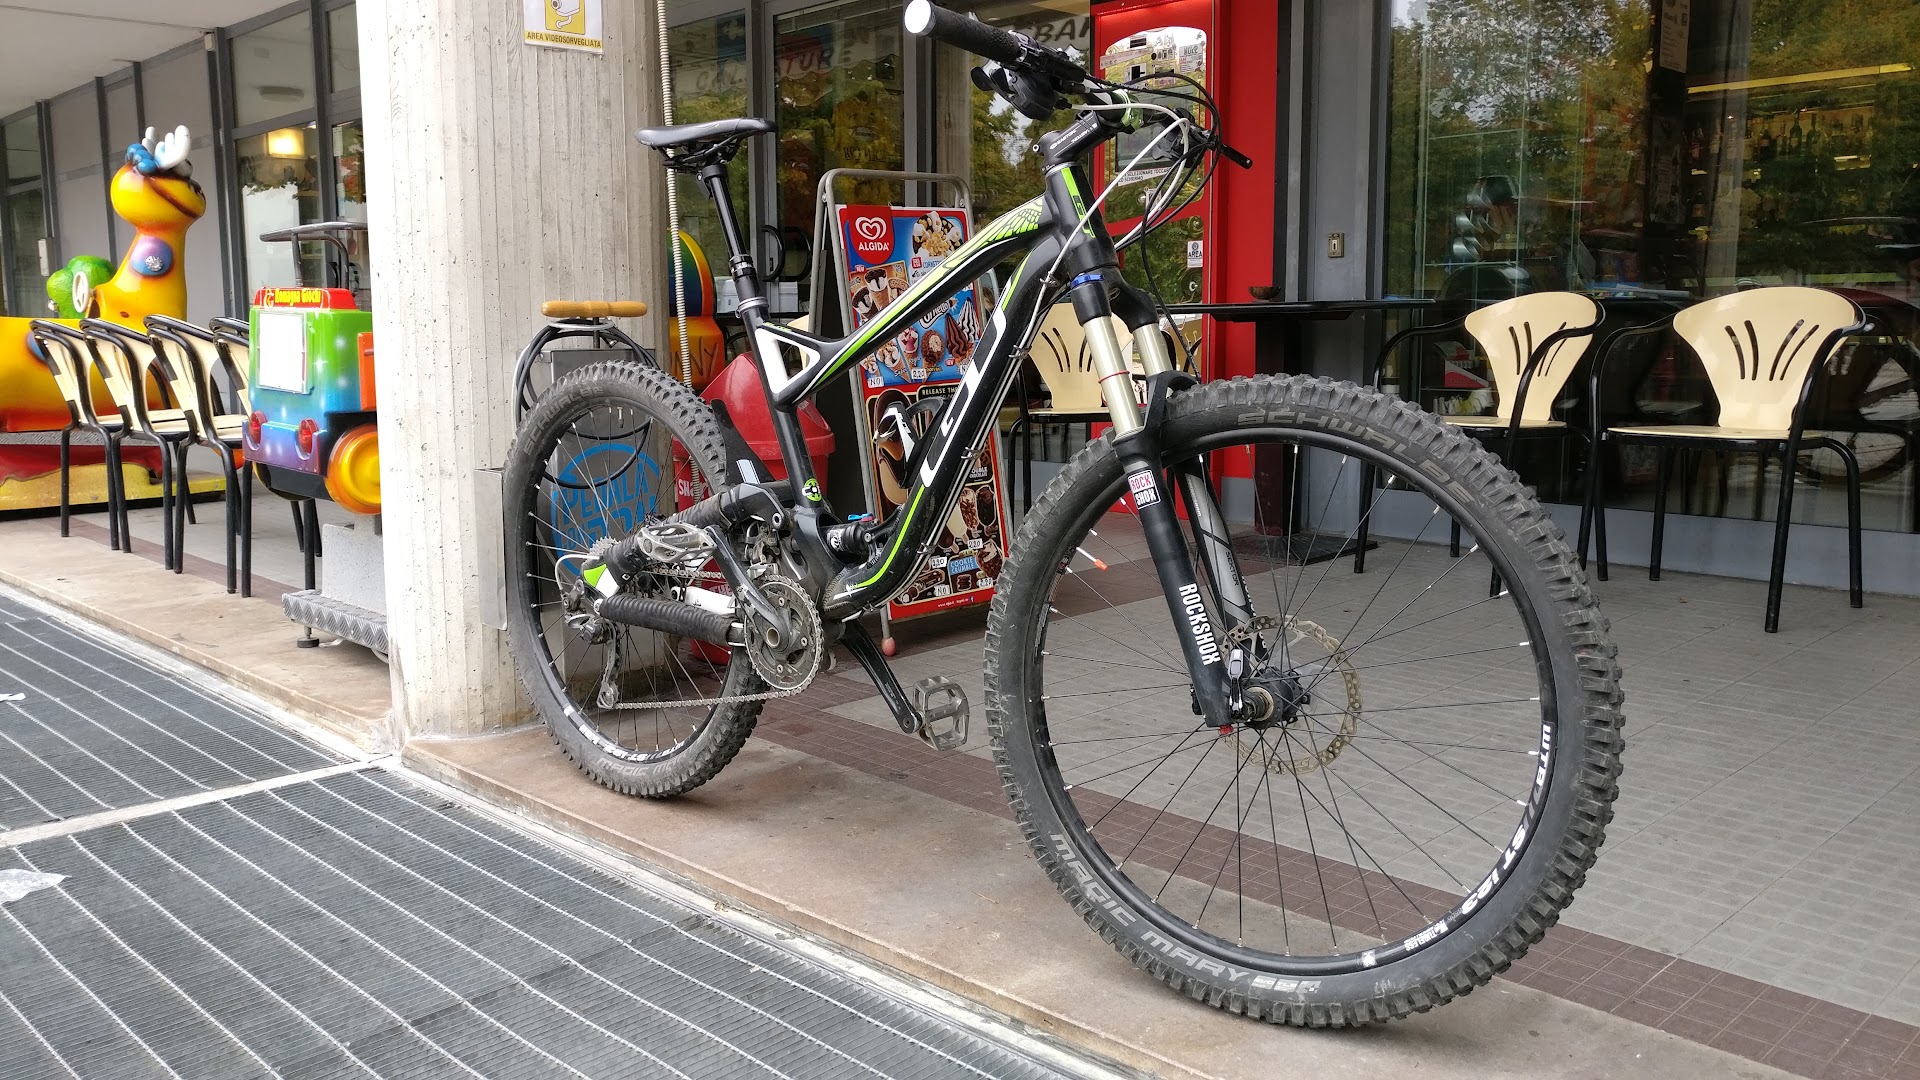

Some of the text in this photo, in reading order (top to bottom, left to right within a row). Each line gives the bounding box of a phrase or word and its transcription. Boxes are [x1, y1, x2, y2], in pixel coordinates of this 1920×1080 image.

[527, 31, 602, 48] AREA VIDEOSORVEGLIATA
[858, 241, 889, 251] ALGIDA
[921, 387, 946, 395] RELEASE
[1236, 407, 1476, 503] SCHWALBE
[1130, 474, 1152, 491] ROCK
[1134, 488, 1157, 506] SHOX
[950, 556, 974, 568] COOKIE
[1225, 551, 1240, 587] SEKTOR
[1178, 582, 1222, 666] ROCKSHOX
[1050, 833, 1250, 982] MAGIC MARY
